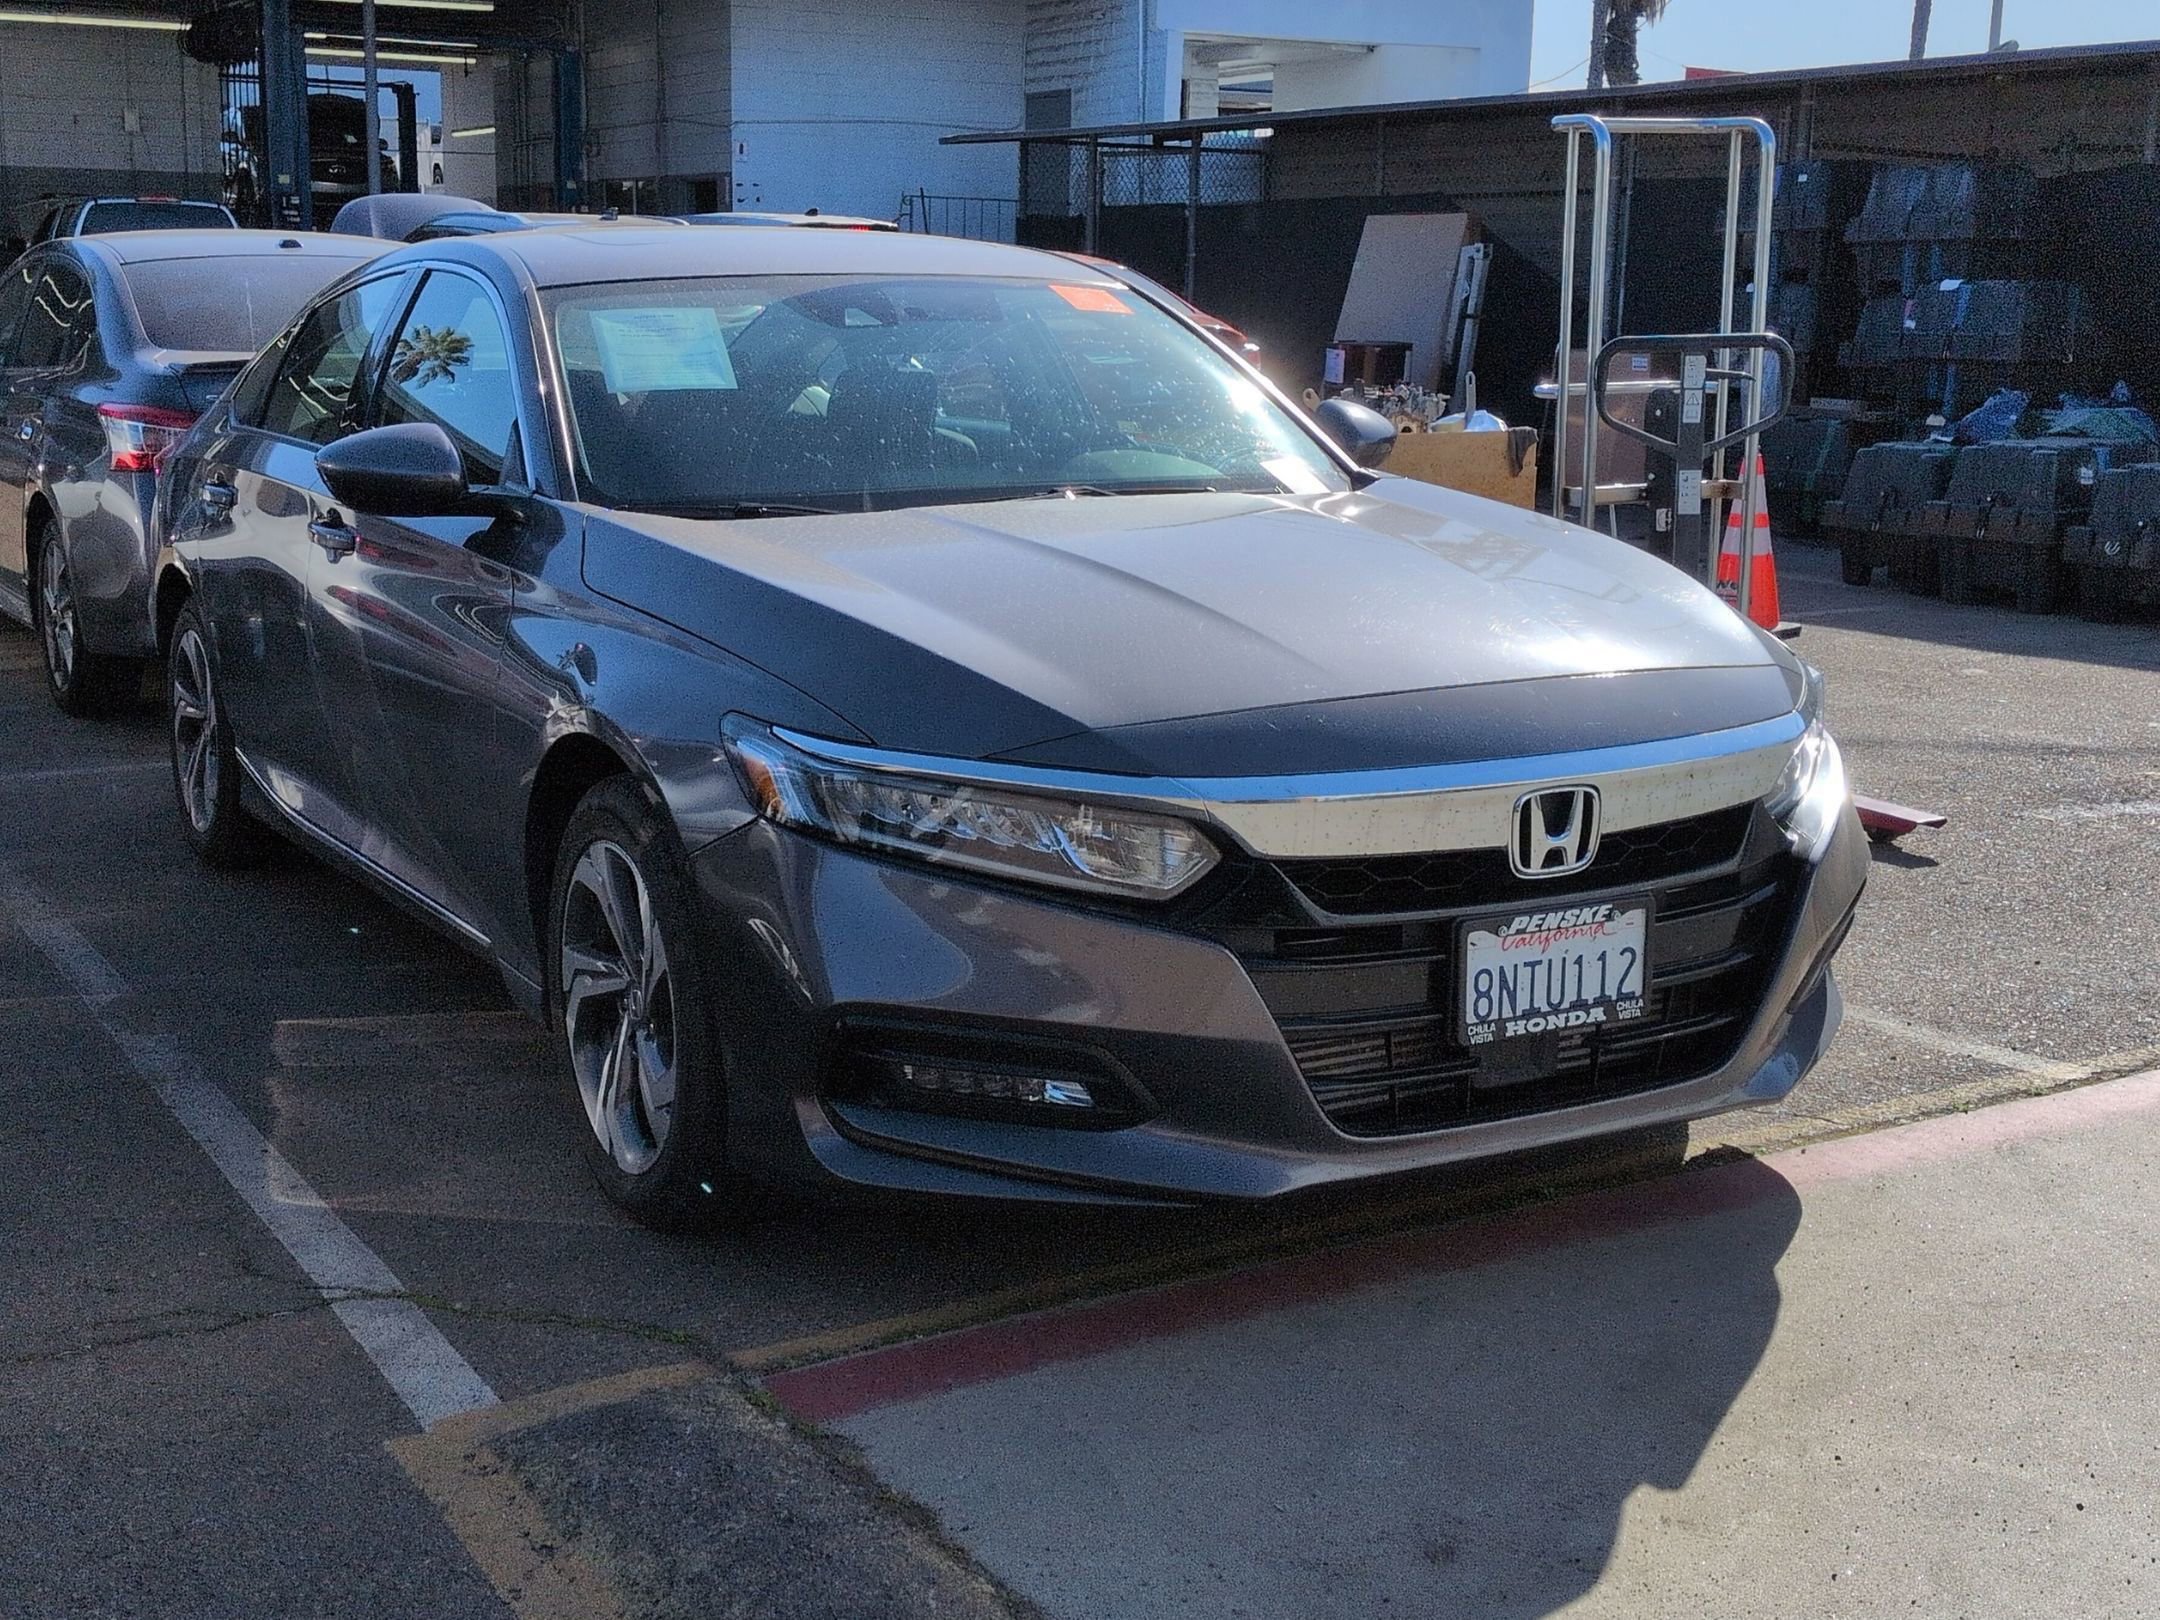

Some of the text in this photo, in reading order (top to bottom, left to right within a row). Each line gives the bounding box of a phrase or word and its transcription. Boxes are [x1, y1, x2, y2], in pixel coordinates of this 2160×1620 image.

[1507, 904, 1613, 935] PENSKE
[1501, 921, 1617, 954] California
[1616, 999, 1644, 1011] CHULA
[1618, 1008, 1642, 1019] VISTA
[1505, 1007, 1607, 1037] HONDA
[1467, 1023, 1496, 1035] CHULA
[1469, 1033, 1494, 1045] VISTA
